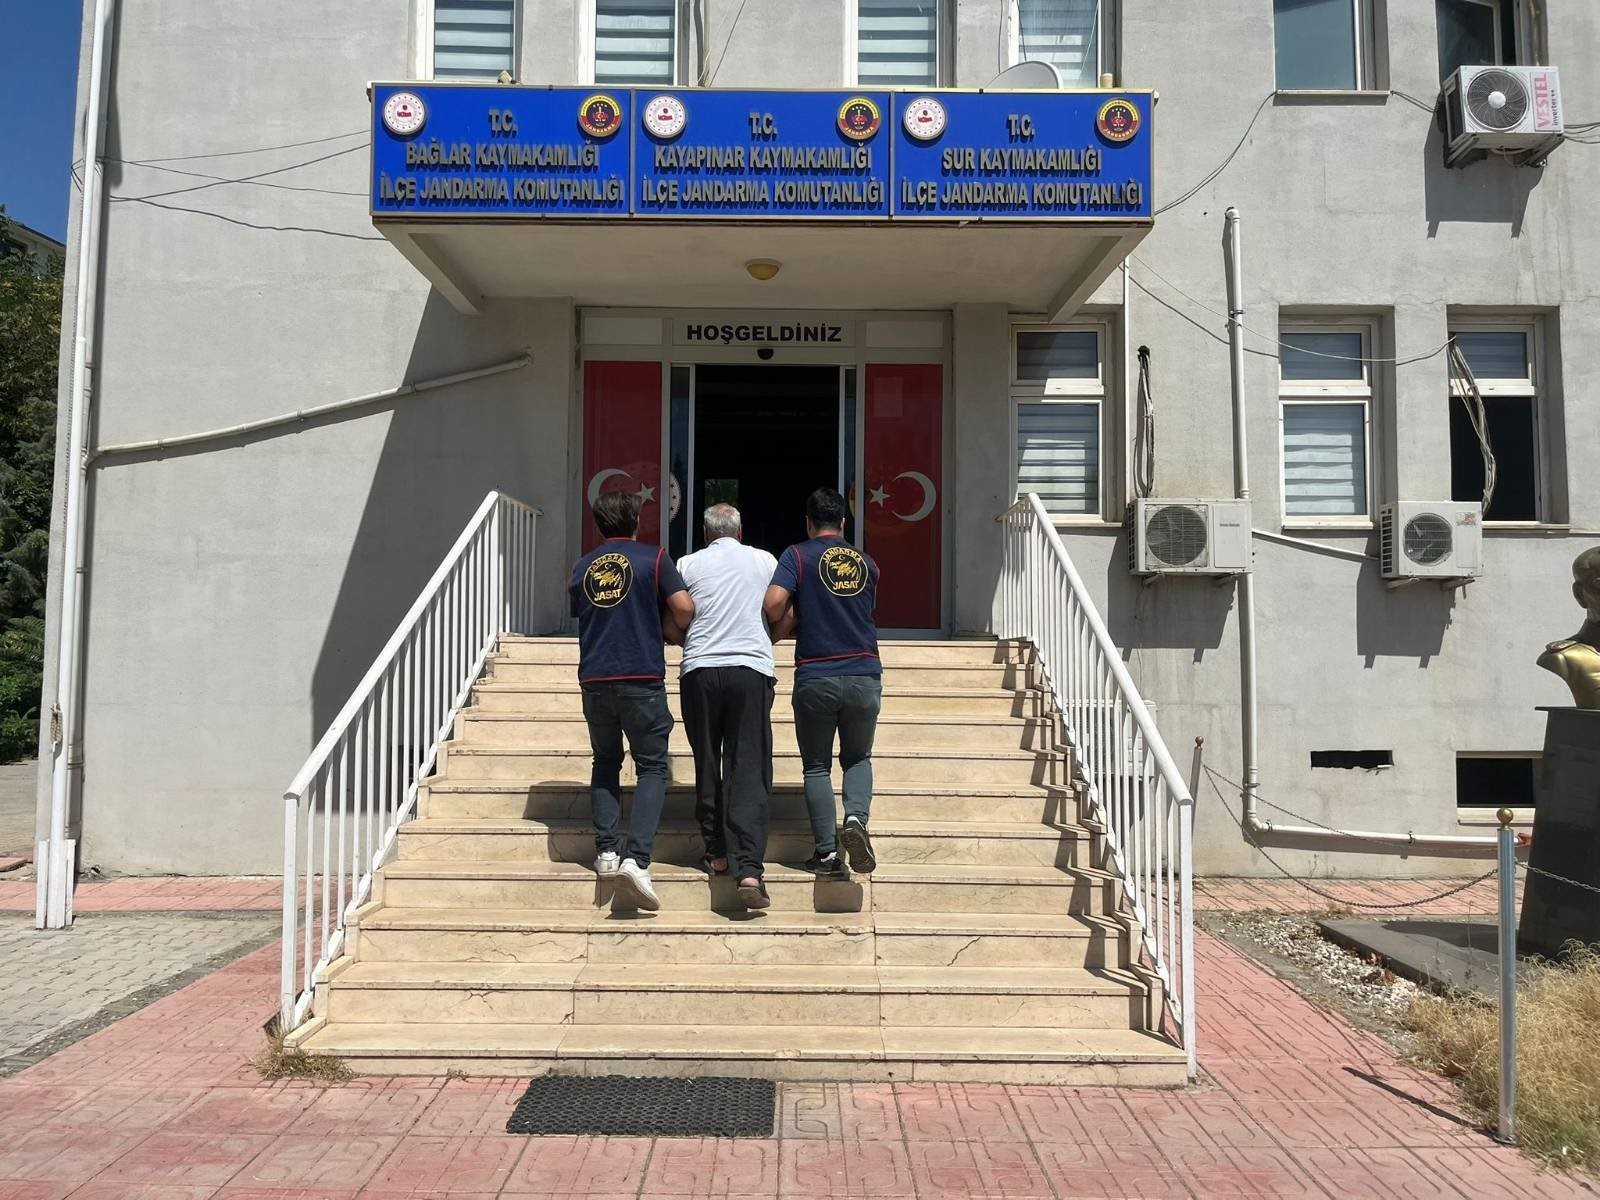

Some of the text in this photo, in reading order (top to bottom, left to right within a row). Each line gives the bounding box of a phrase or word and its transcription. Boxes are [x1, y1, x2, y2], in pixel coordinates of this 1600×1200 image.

[1534, 73, 1551, 128] VESTEL
[489, 109, 518, 133] T.C.
[750, 112, 778, 135] T.C.
[1008, 114, 1036, 136] T.C.
[406, 137, 599, 167] BAĞLAR KAYMAKAMLIĞI
[655, 142, 872, 169] KAYAPINAR KAYMAKAMLIĞI
[943, 145, 1102, 171] SUR KAYMAKAMLIĞI
[379, 172, 625, 201] İLÇE JANDARMA KOMUTANLIĞI
[642, 173, 885, 204] İLÇE JANDARMA KOMUTANLIĞI
[902, 177, 1143, 206] İLÇE JANDARMA KOMUTANLIĞI
[687, 323, 842, 345] HOŞGELDİNİZ
[594, 588, 622, 601] JASAT
[832, 580, 860, 590] JASAT
